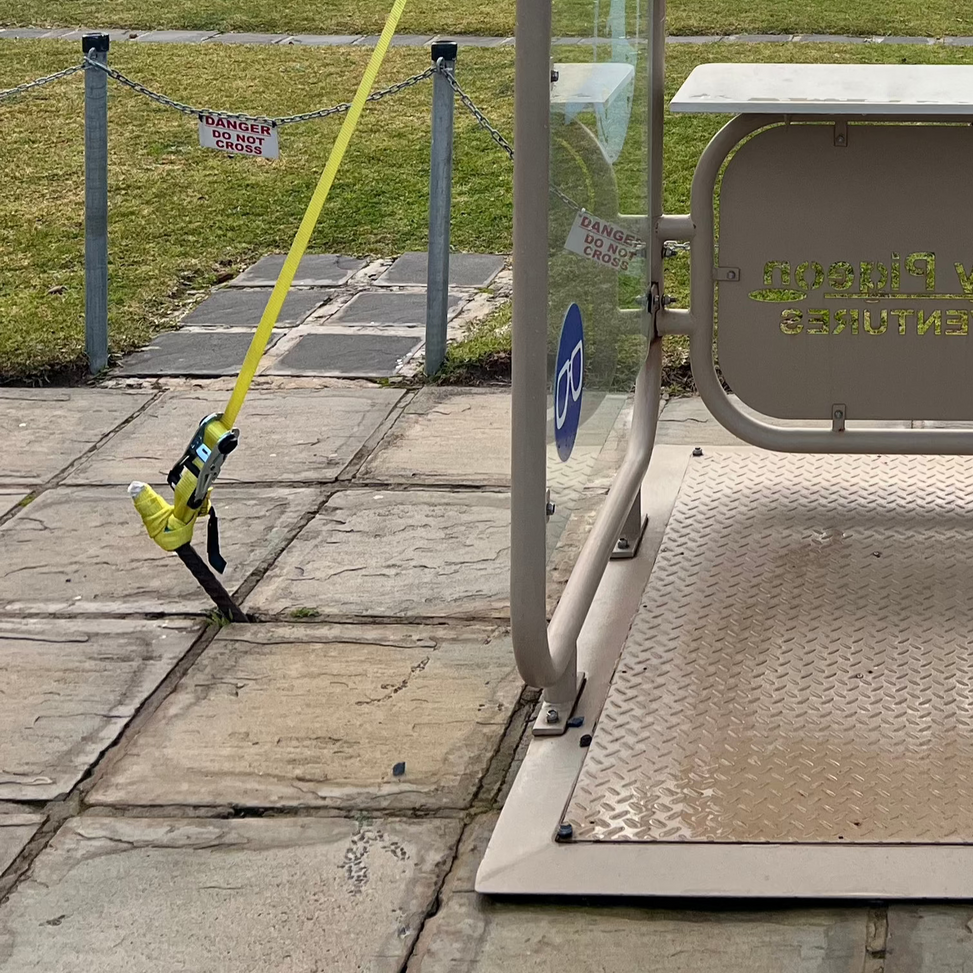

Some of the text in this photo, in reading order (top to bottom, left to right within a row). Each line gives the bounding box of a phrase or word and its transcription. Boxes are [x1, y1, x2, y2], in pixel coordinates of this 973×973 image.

[205, 115, 271, 135] DANGER
[212, 129, 265, 146] DO NOT
[215, 139, 263, 155] CROSS
[584, 233, 637, 262] DO NOT
[583, 245, 629, 271] CROSS
